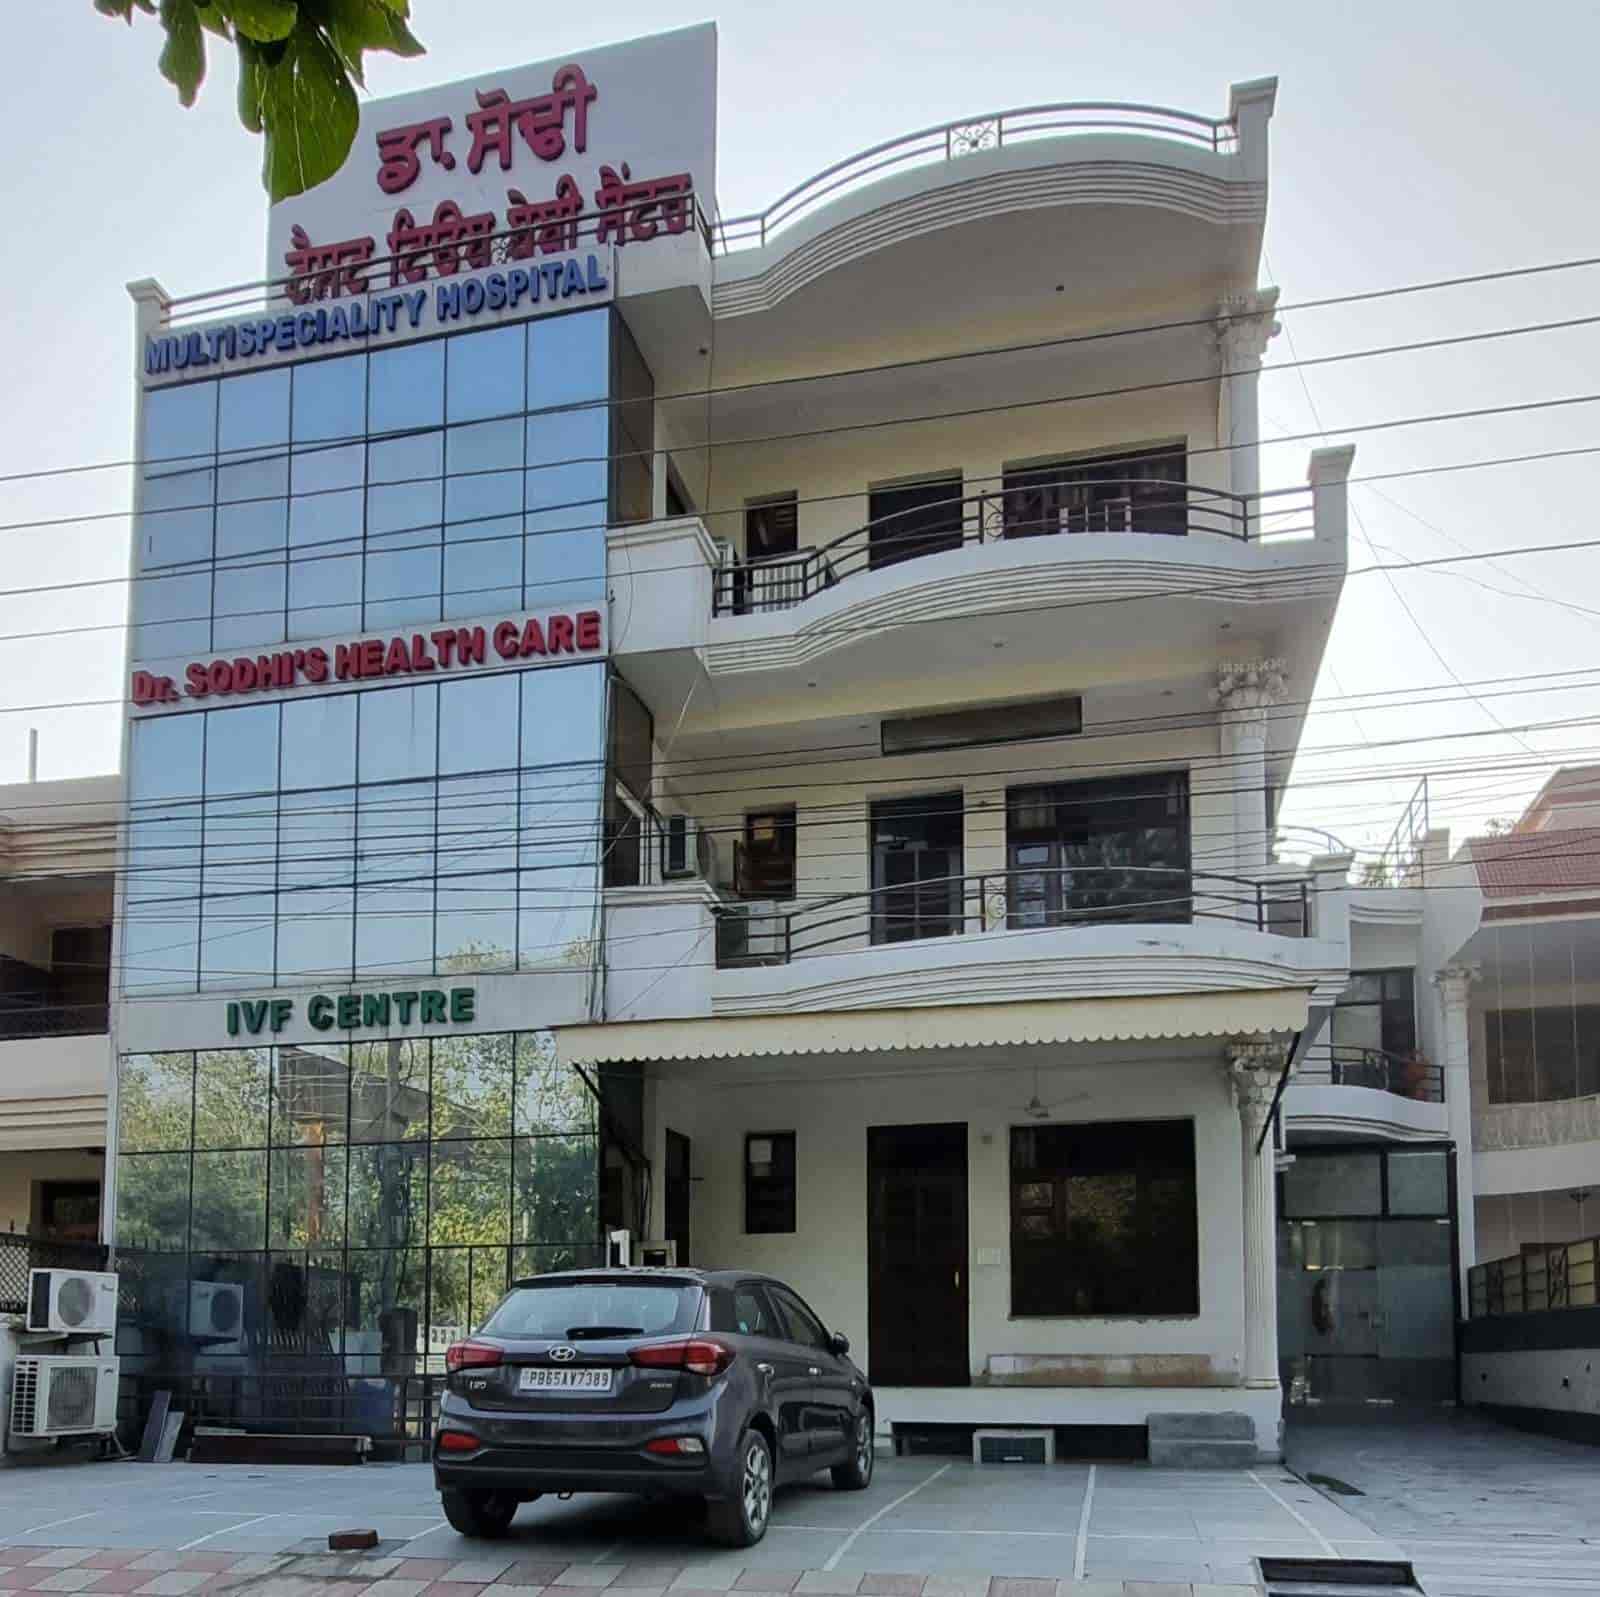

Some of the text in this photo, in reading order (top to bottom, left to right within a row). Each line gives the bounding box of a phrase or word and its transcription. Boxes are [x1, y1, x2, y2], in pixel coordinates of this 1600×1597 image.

[466, 64, 598, 174] ਸੋਢੀ
[144, 254, 608, 375] MULTISPECIALITY HOSPITAL
[132, 610, 602, 707] Dr. SODHI'S HEALTH CARE
[226, 987, 475, 1036] IVF CENTRE
